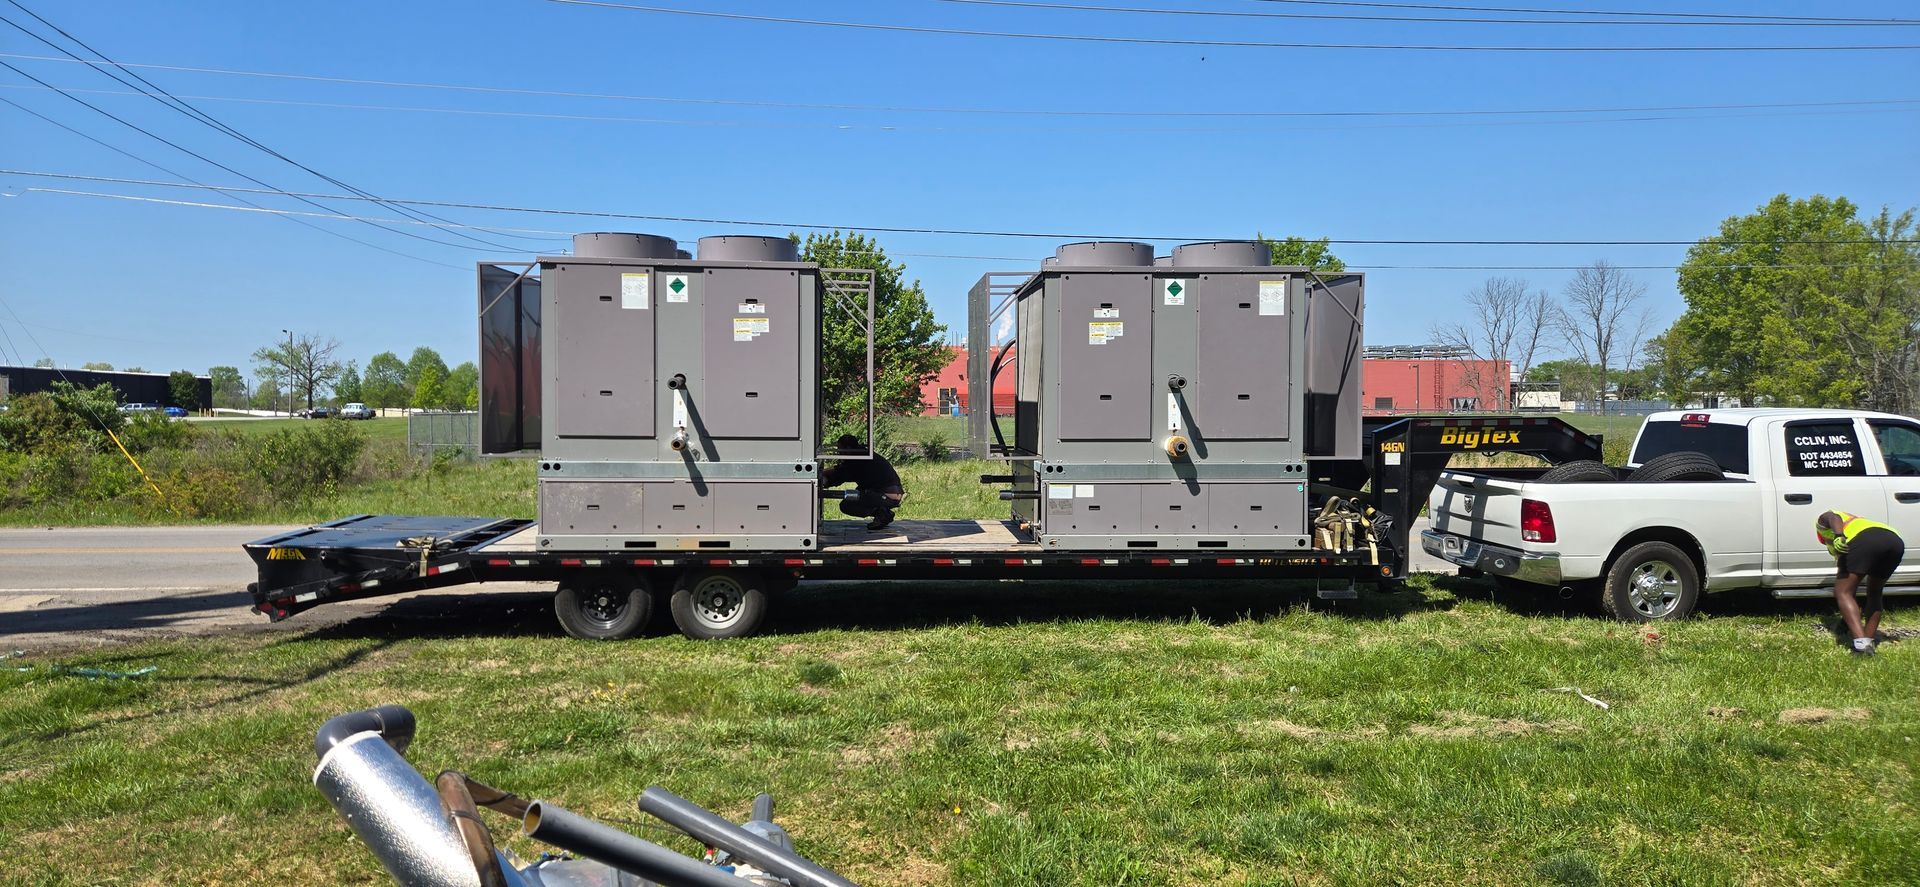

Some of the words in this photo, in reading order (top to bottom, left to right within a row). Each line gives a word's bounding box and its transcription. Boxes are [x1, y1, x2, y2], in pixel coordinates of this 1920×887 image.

[1440, 426, 1521, 449] BigTex
[1794, 436, 1828, 446] CCLIV,
[1829, 435, 1851, 444] INC.
[1381, 442, 1405, 453] 14GN
[1800, 452, 1818, 460] DOT
[1819, 451, 1853, 459] 4434854
[1804, 460, 1818, 469] MC
[1819, 459, 1852, 468] 1745491
[266, 548, 306, 560] MEGA
